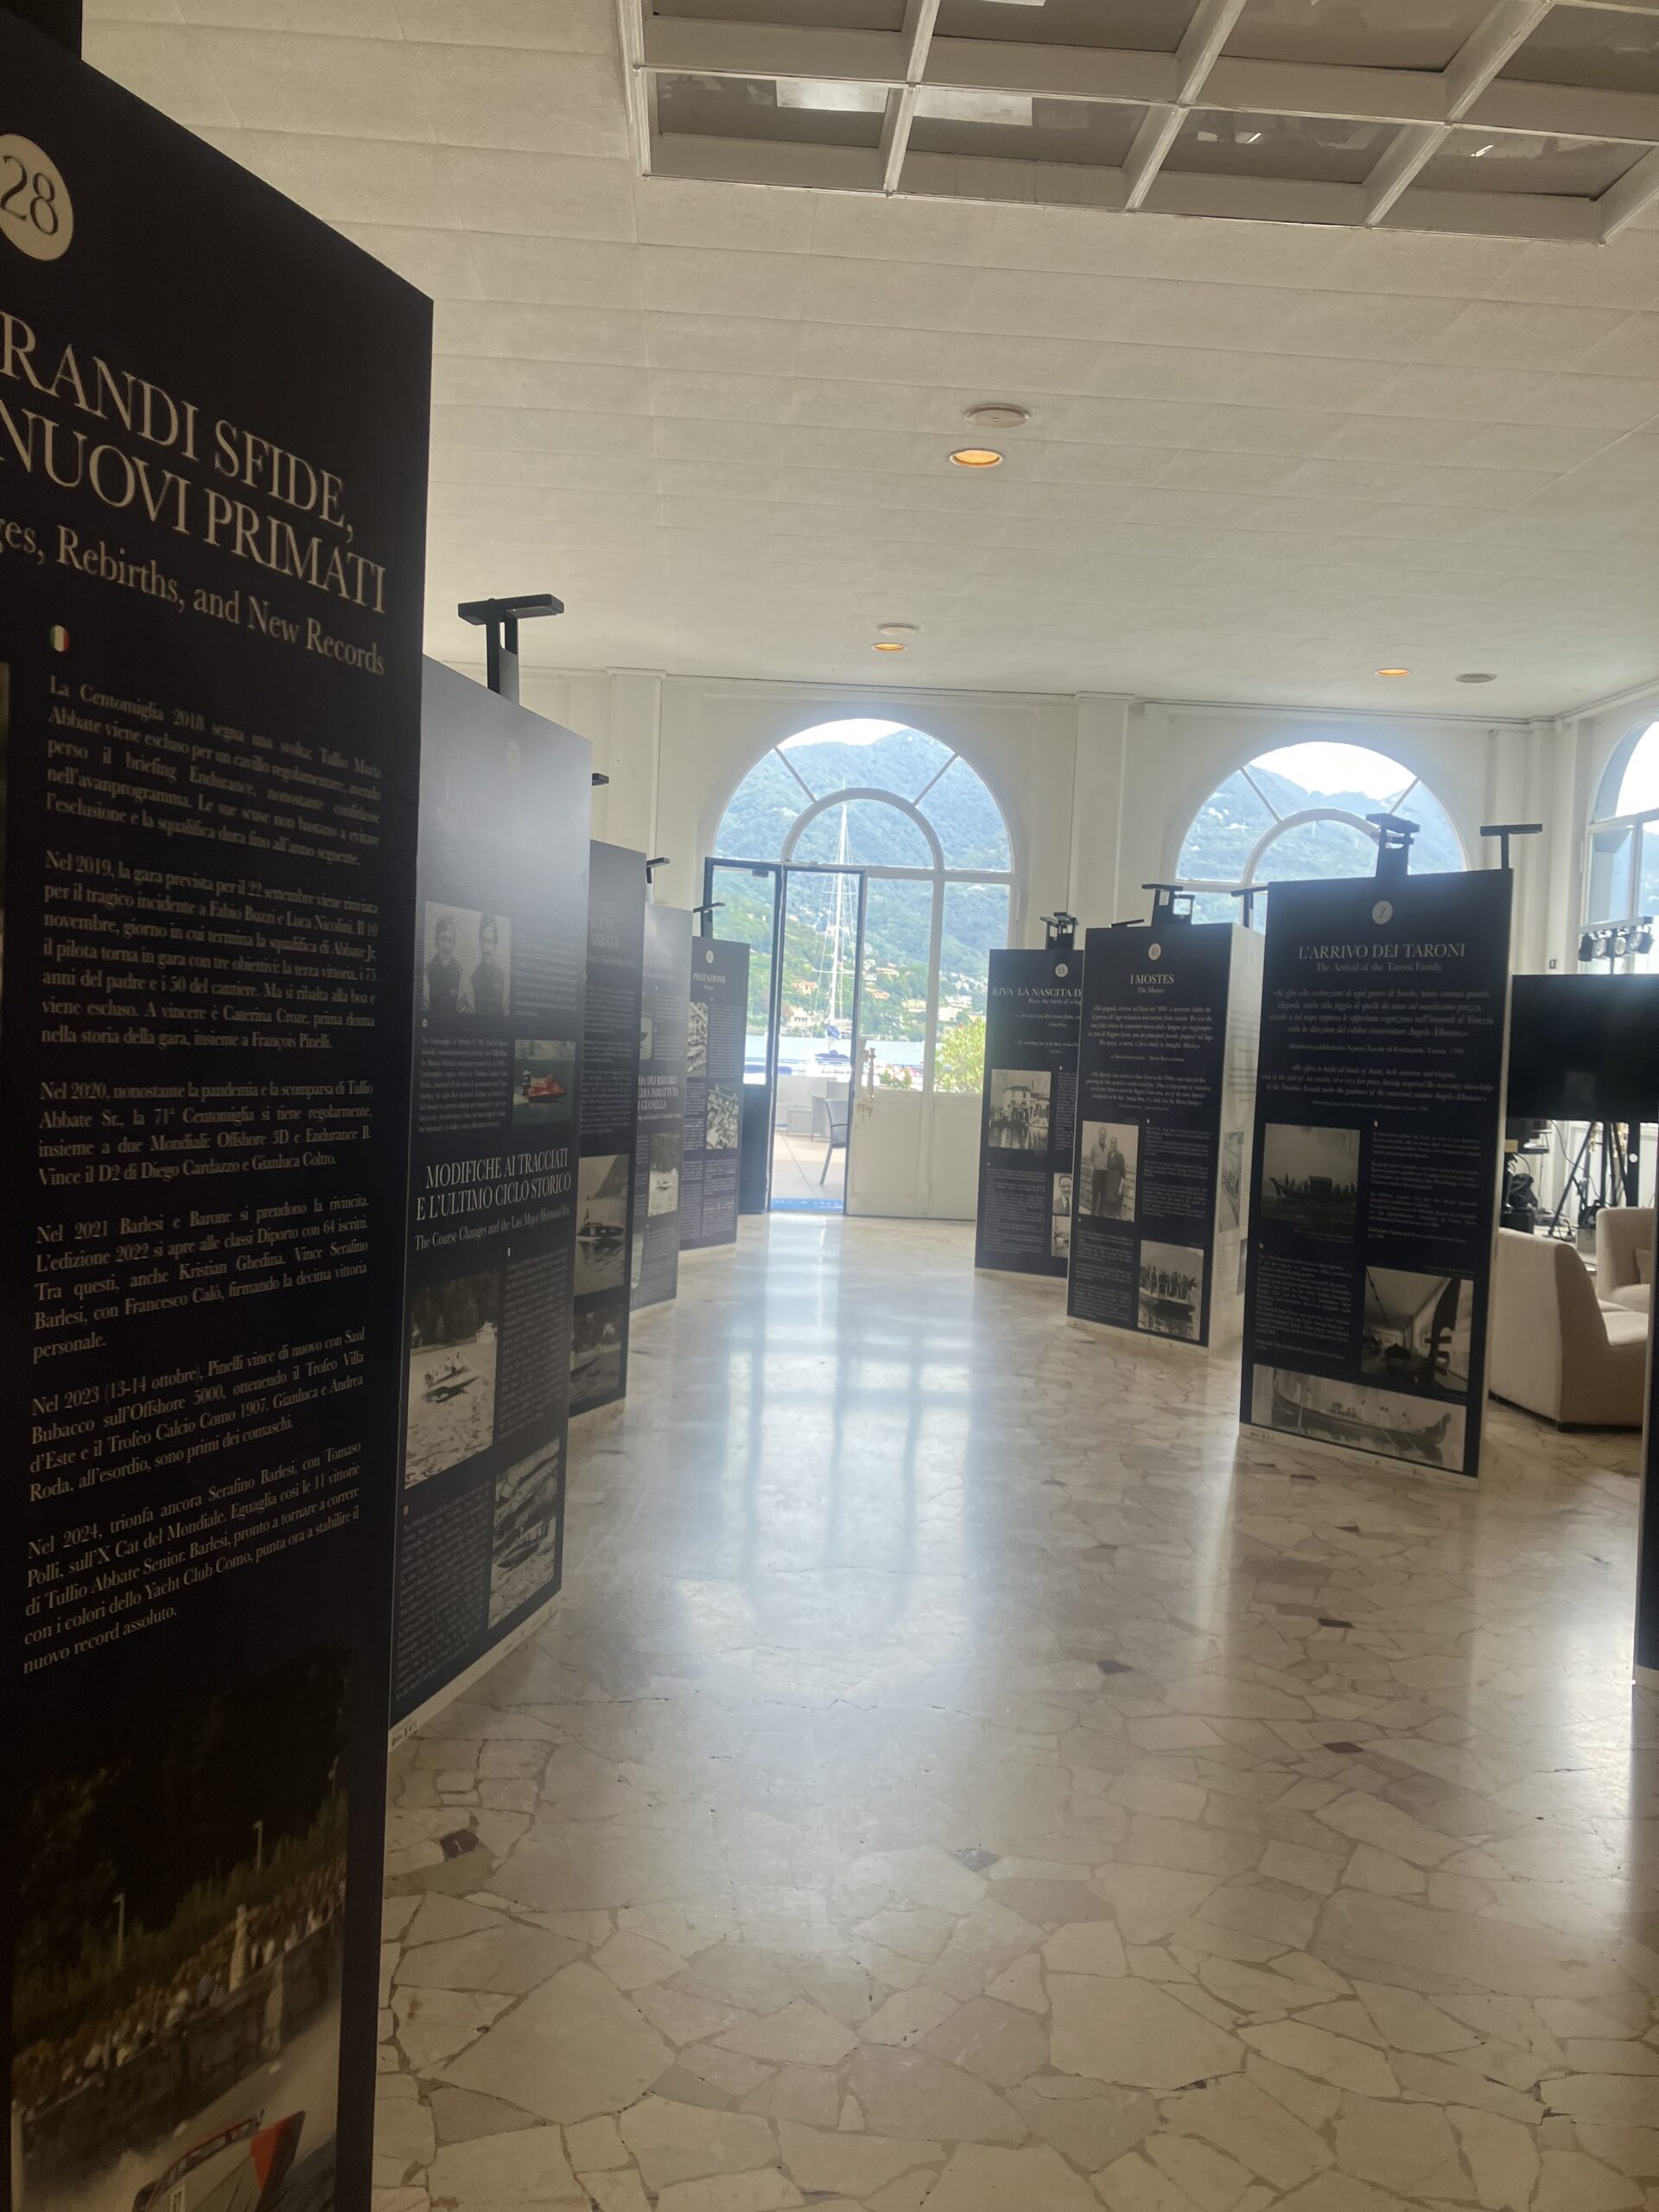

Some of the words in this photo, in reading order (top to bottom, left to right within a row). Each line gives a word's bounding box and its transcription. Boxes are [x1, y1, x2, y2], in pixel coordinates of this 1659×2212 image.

[1, 156, 59, 236] 28
[0, 398, 191, 536] NUOVI
[203, 487, 387, 614] PRIMATI
[214, 419, 354, 543] SFIDE,
[0, 519, 44, 564] es,
[56, 524, 184, 613] Rebirths,
[194, 588, 240, 625] and
[248, 595, 301, 645] New
[305, 617, 385, 677] Records
[50, 675, 69, 697] La
[79, 683, 165, 722] Centomiglia
[173, 708, 205, 732] 2018
[45, 849, 72, 871] Nel
[118, 861, 130, 879] la
[133, 868, 163, 886] gara
[1135, 975, 1174, 984] MOSTES
[1299, 944, 1369, 959] L'ARRIVO
[1372, 944, 1399, 958] DEI
[1403, 943, 1465, 958] TARONI
[1316, 963, 1331, 972] The
[1361, 963, 1370, 971] of
[1372, 963, 1384, 971] the
[1386, 962, 1414, 971] Taroni
[1017, 987, 1029, 995] LA
[1032, 988, 1071, 996] NASCITA
[39, 1167, 81, 1185] Vince
[85, 1166, 94, 1183] il
[99, 1164, 120, 1182] D2
[124, 1162, 137, 1180] di
[141, 1161, 180, 1182] Diego
[242, 1160, 249, 1172] e
[251, 1154, 300, 1170] Gianluca
[416, 1197, 425, 1221] E
[429, 1186, 493, 1219] L'ULTIMO
[496, 1179, 529, 1206] CICLO
[531, 1172, 572, 1199] STORICO
[425, 1157, 503, 1189] MODIFICHE
[504, 1155, 516, 1177] AI
[518, 1147, 569, 1175] TRACCIATI
[415, 1235, 431, 1250] The
[432, 1231, 457, 1247] Course
[460, 1225, 487, 1243] Changes
[488, 1218, 500, 1235] and
[501, 1217, 511, 1232] the
[35, 1306, 87, 1330] Barlesi,
[93, 1306, 118, 1320] con
[124, 1294, 188, 1316] Francesco
[229, 1275, 280, 1297] firmando
[283, 1273, 292, 1288] la
[296, 1268, 331, 1286] decima
[334, 1260, 367, 1278] vittoria
[31, 1394, 59, 1416] Nel
[64, 1385, 99, 1409] 2023
[105, 1376, 147, 1404] (13-14
[207, 1354, 244, 1376] Pinelli
[247, 1351, 275, 1367] vince
[278, 1344, 289, 1360] di
[292, 1341, 322, 1357] nuovo
[325, 1336, 342, 1349] con
[346, 1325, 365, 1344] Saul
[33, 1331, 107, 1365] personale.
[29, 1450, 77, 1472] d'Este
[80, 1447, 89, 1460] e
[93, 1440, 103, 1457] il
[107, 1430, 152, 1453] Trofeo
[156, 1417, 195, 1440] Calcio
[200, 1410, 236, 1428] Como
[273, 1388, 318, 1409] Gianluca
[321, 1385, 327, 1396] e
[329, 1374, 364, 1394] Andrea
[31, 1419, 95, 1445] Bubacco
[104, 1397, 187, 1427] sull'Offshore
[233, 1370, 287, 1395] ottenendo
[293, 1365, 300, 1381] il
[306, 1357, 338, 1376] Trofeo
[343, 1350, 364, 1366] Villa
[29, 1477, 74, 1502] Roda,
[79, 1456, 151, 1489] all'esordio,
[154, 1450, 184, 1468] sono
[187, 1434, 219, 1463] primi
[222, 1429, 240, 1448] dei
[242, 1414, 294, 1442] comaschi.
[27, 1535, 54, 1560] Nel
[62, 1522, 103, 1548] 2024,
[110, 1506, 154, 1534] trionfa
[160, 1495, 202, 1518] ancora
[208, 1478, 256, 1503] Serafino
[302, 1456, 321, 1471] con
[325, 1442, 361, 1463] Tomaso
[115, 1540, 139, 1558] Cat
[143, 1528, 163, 1549] del
[231, 1491, 277, 1521] Eguaglia
[302, 1480, 311, 1494] le
[328, 1461, 360, 1484] vittorie
[24, 1625, 53, 1645] con
[56, 1617, 61, 1634] i
[65, 1600, 106, 1630] colori
[109, 1590, 143, 1614] dello
[144, 1576, 181, 1600] Yacht
[183, 1563, 213, 1586] Club
[216, 1552, 254, 1573] Como,
[255, 1538, 286, 1564] punta
[288, 1531, 306, 1546] ora
[307, 1529, 314, 1539] a
[315, 1511, 352, 1535] stabilire
[353, 1504, 359, 1520] il
[22, 1647, 70, 1675] nuovo
[73, 1622, 119, 1655] record
[123, 1606, 177, 1636] assoluto.
